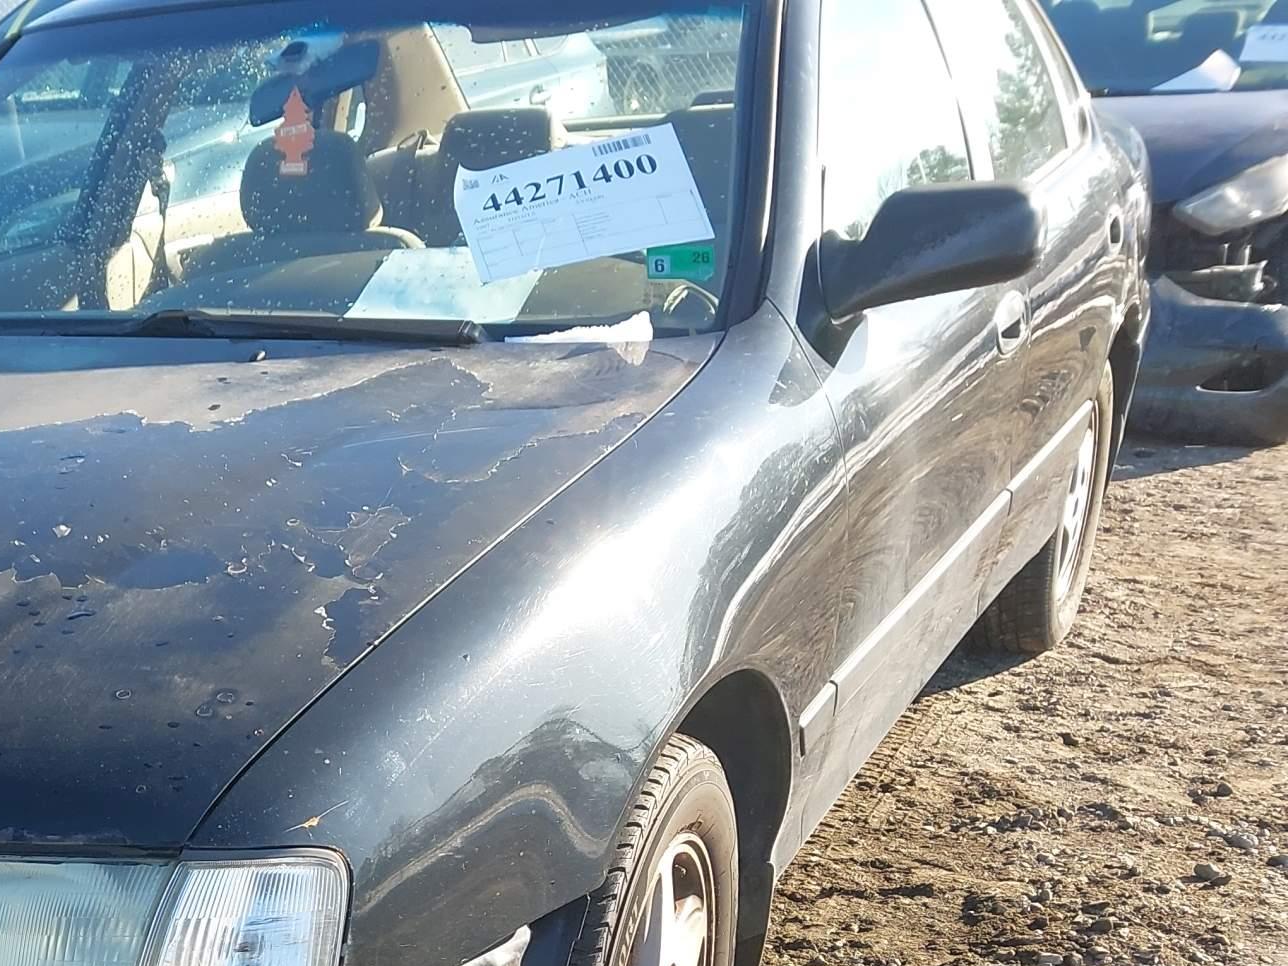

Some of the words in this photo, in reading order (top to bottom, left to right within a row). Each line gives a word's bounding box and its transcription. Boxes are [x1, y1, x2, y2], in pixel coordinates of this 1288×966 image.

[482, 154, 658, 211] 44271400
[654, 258, 666, 273] 6
[692, 251, 710, 265] 26
